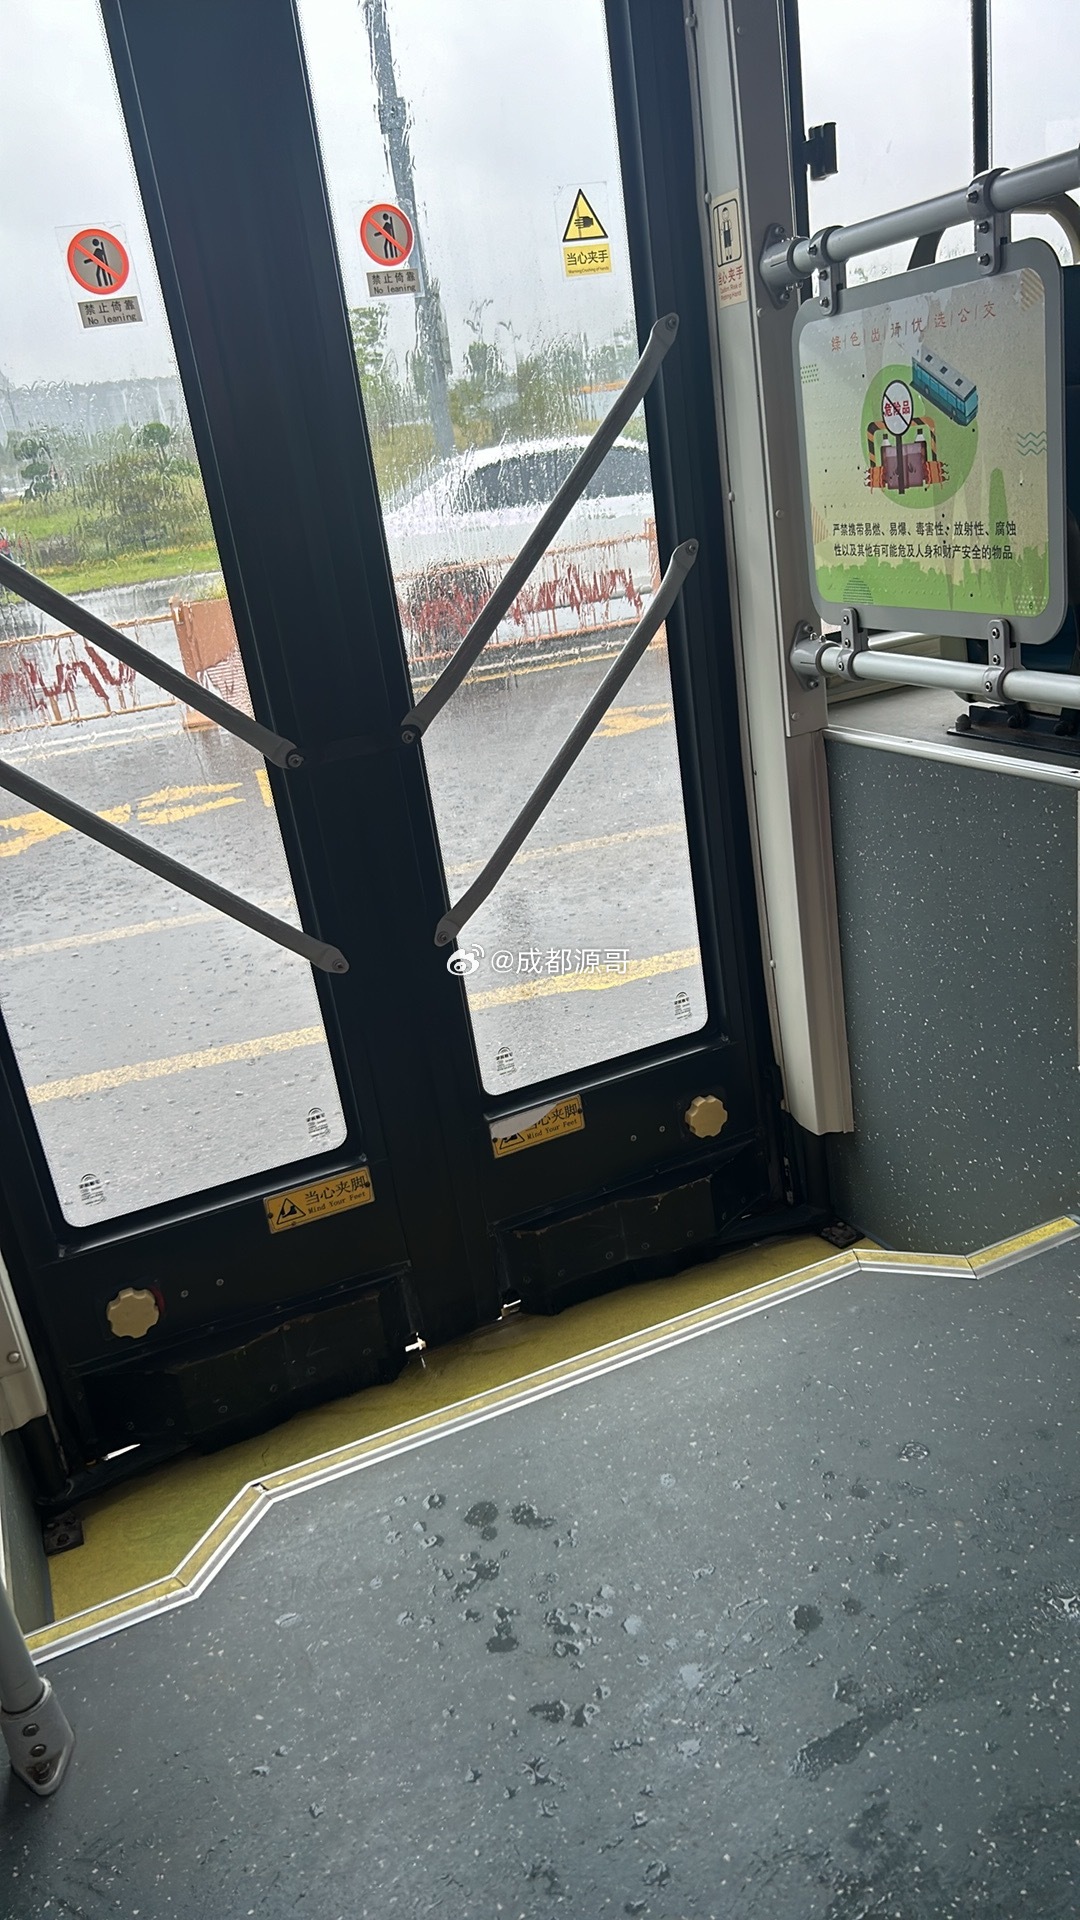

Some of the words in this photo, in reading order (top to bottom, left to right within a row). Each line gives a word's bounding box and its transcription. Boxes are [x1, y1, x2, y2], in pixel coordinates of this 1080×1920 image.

[567, 250, 609, 266] 当心夹手
[372, 272, 416, 285] 禁止倚靠
[387, 285, 416, 293] leaning
[85, 299, 136, 315] 禁止倚靠
[87, 316, 99, 325] No
[103, 313, 136, 323] leaning
[884, 400, 910, 417] 危险品
[833, 543, 1013, 560] 性以及其他有可能危及人身和财产安全的物品
[527, 1130, 543, 1140] Mind
[545, 1124, 560, 1134] Your
[563, 1119, 578, 1128] Feet
[305, 1176, 366, 1205] 当心夹脚
[308, 1204, 326, 1214] Mind
[329, 1199, 346, 1207] Your
[349, 1192, 366, 1200] Feet
